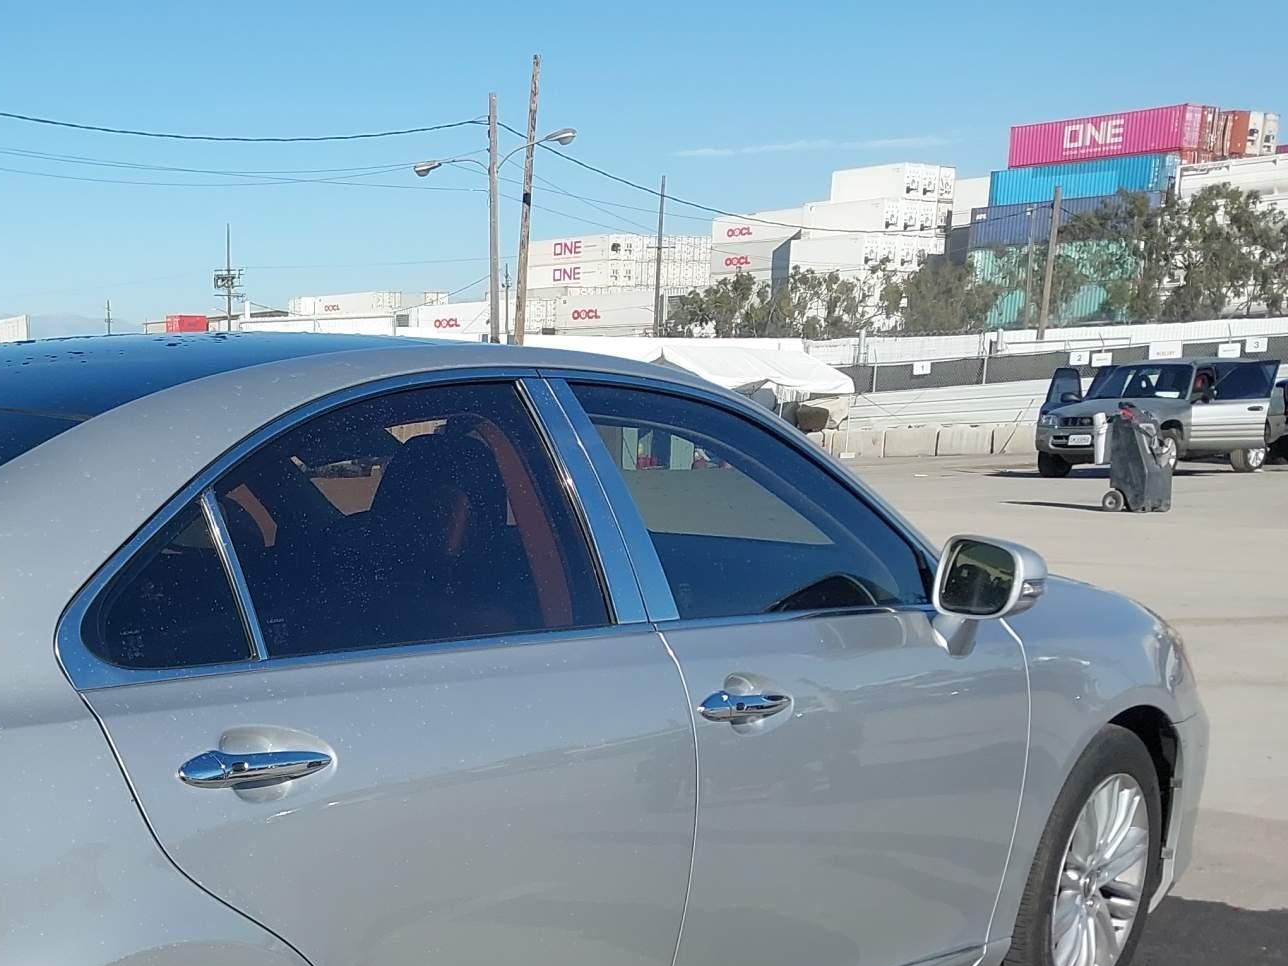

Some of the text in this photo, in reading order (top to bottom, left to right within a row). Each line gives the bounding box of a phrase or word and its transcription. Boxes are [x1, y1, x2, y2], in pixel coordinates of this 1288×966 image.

[1063, 119, 1124, 149] ONE
[727, 226, 752, 237] OOCL
[553, 240, 582, 256] ONE
[725, 256, 751, 266] OOCL
[553, 267, 581, 281] ONE
[572, 309, 600, 320] OOCL
[434, 318, 460, 328] OOCL
[1253, 341, 1260, 349] 3
